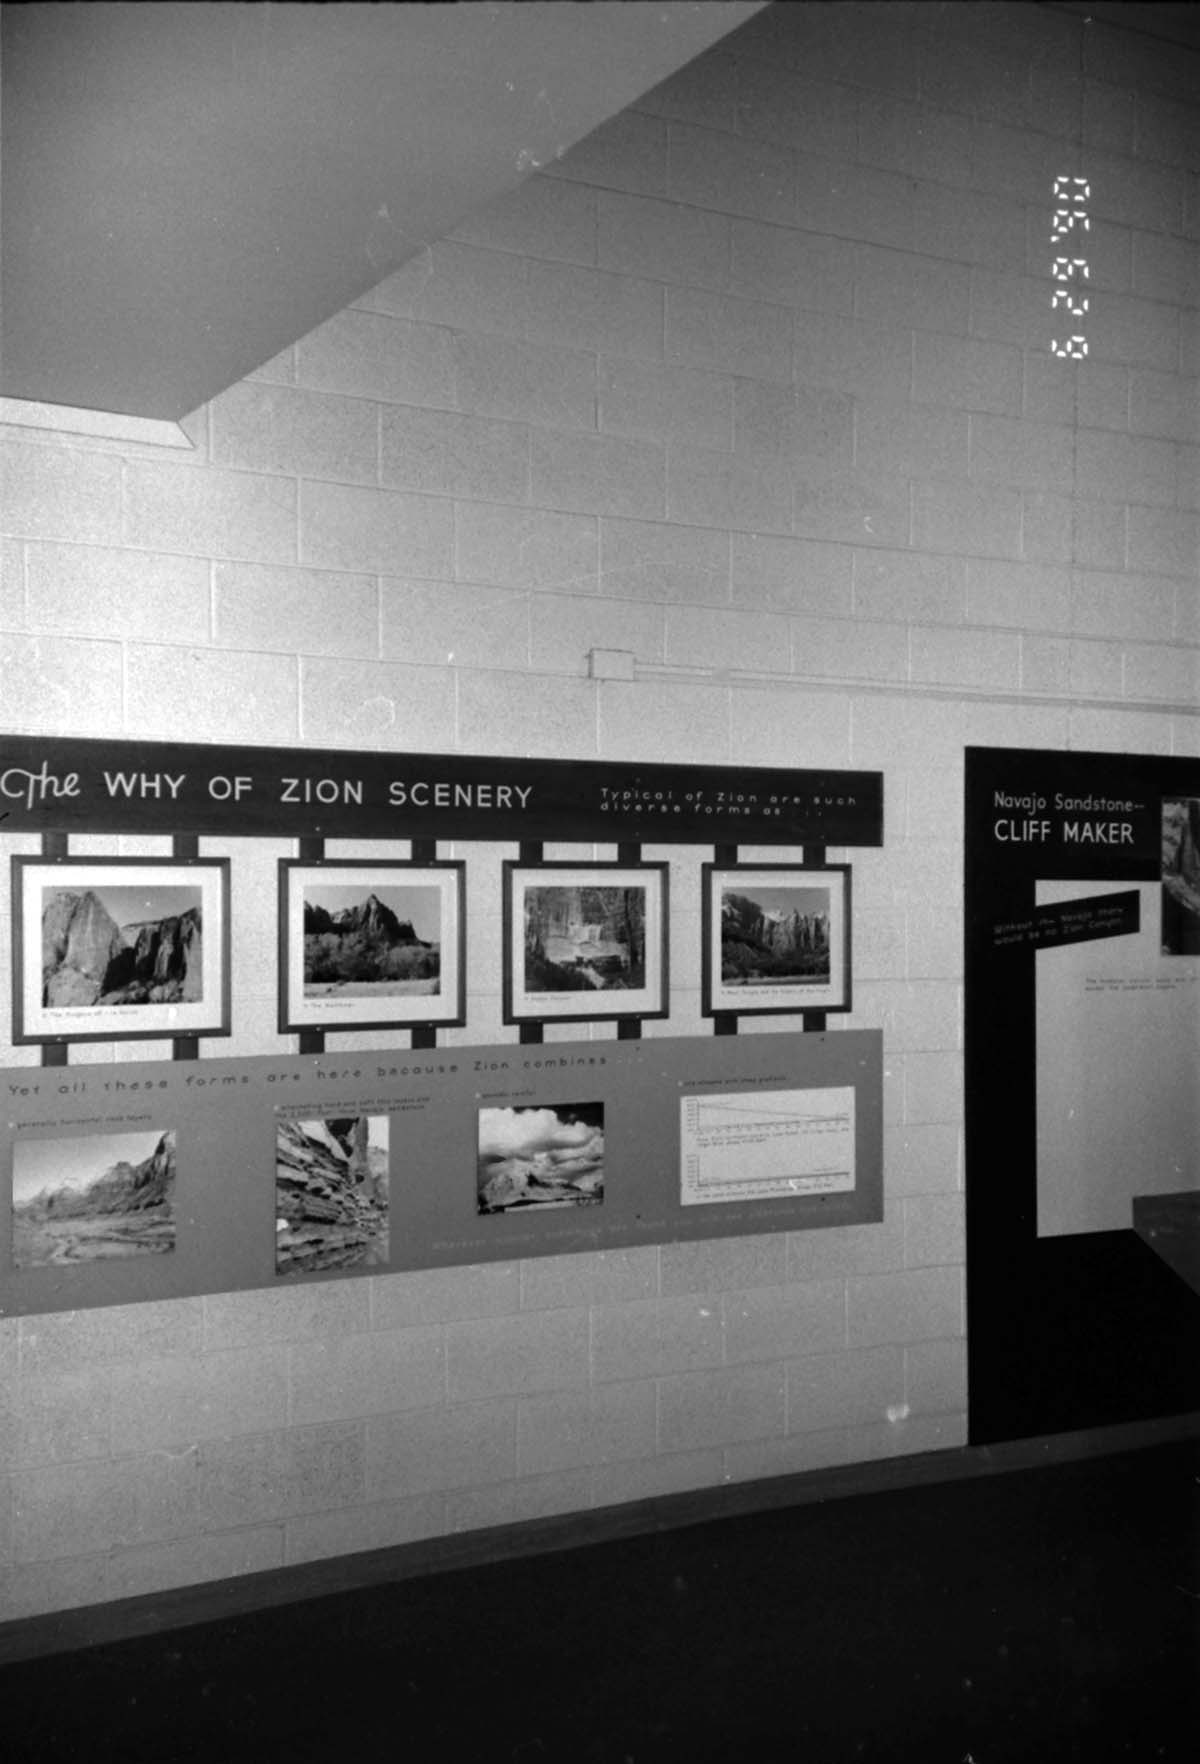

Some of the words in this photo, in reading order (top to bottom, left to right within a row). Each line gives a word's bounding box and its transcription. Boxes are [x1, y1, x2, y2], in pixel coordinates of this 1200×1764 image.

[0, 760, 81, 811] The
[104, 772, 187, 800] WHY
[208, 776, 253, 801] OF
[280, 778, 364, 805] ZION
[388, 781, 534, 809] SCENERY
[600, 787, 673, 801] Typical
[685, 790, 704, 802] of
[717, 791, 758, 804] Zion
[769, 795, 801, 805] are
[813, 795, 857, 806] such
[600, 801, 681, 813] diverse
[693, 803, 751, 816] forms
[762, 805, 781, 816] as
[993, 791, 1047, 817] Navajo
[993, 818, 1052, 842] CLIFF
[1063, 820, 1136, 845] MAKER
[9, 1084, 41, 1097] Yet
[58, 1082, 88, 1095] all
[104, 1079, 169, 1092] these
[185, 1075, 250, 1088] forms
[267, 1072, 302, 1083] are
[316, 1068, 362, 1080] here
[376, 1063, 460, 1078] because
[473, 1060, 510, 1072] Zion
[523, 1054, 608, 1069] combines
